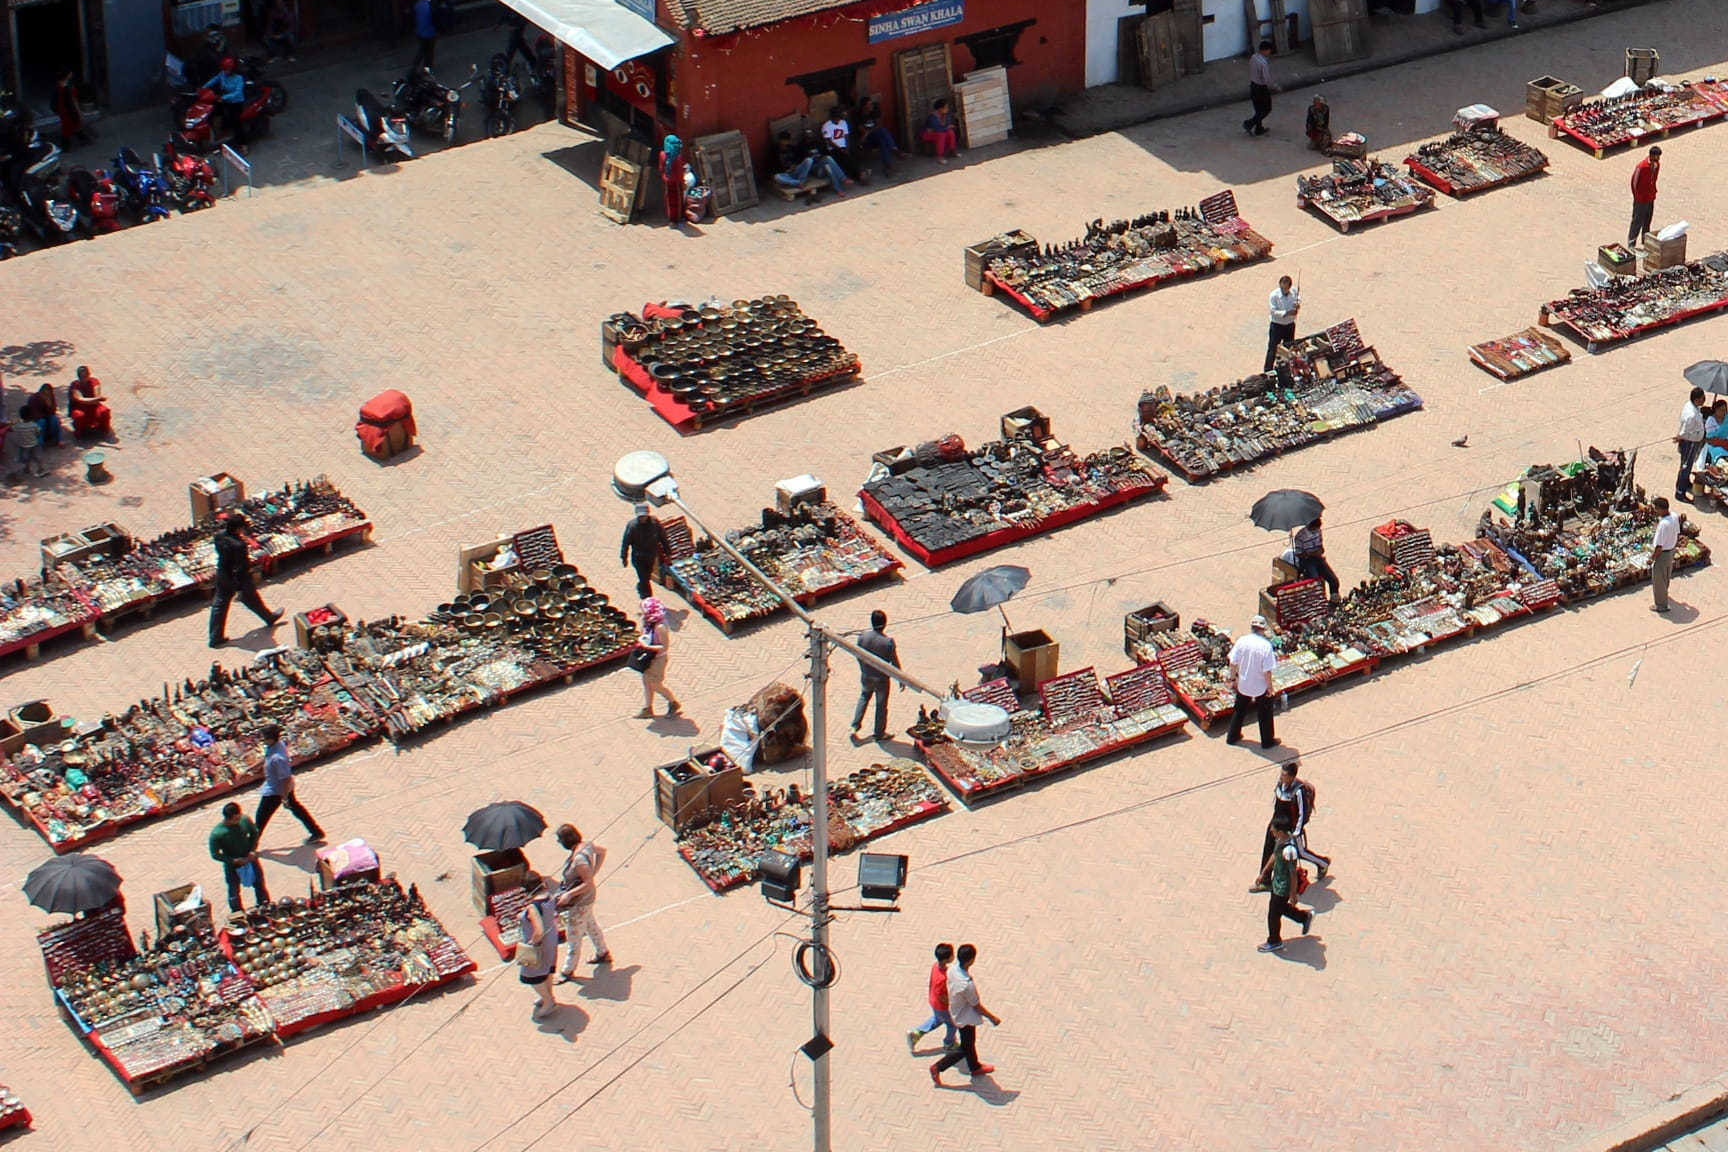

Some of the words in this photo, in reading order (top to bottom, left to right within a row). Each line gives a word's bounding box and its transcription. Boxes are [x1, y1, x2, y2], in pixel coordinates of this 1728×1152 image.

[869, 19, 899, 36] SINHA
[901, 12, 929, 29] SWAN
[930, 5, 963, 21] KHALA
